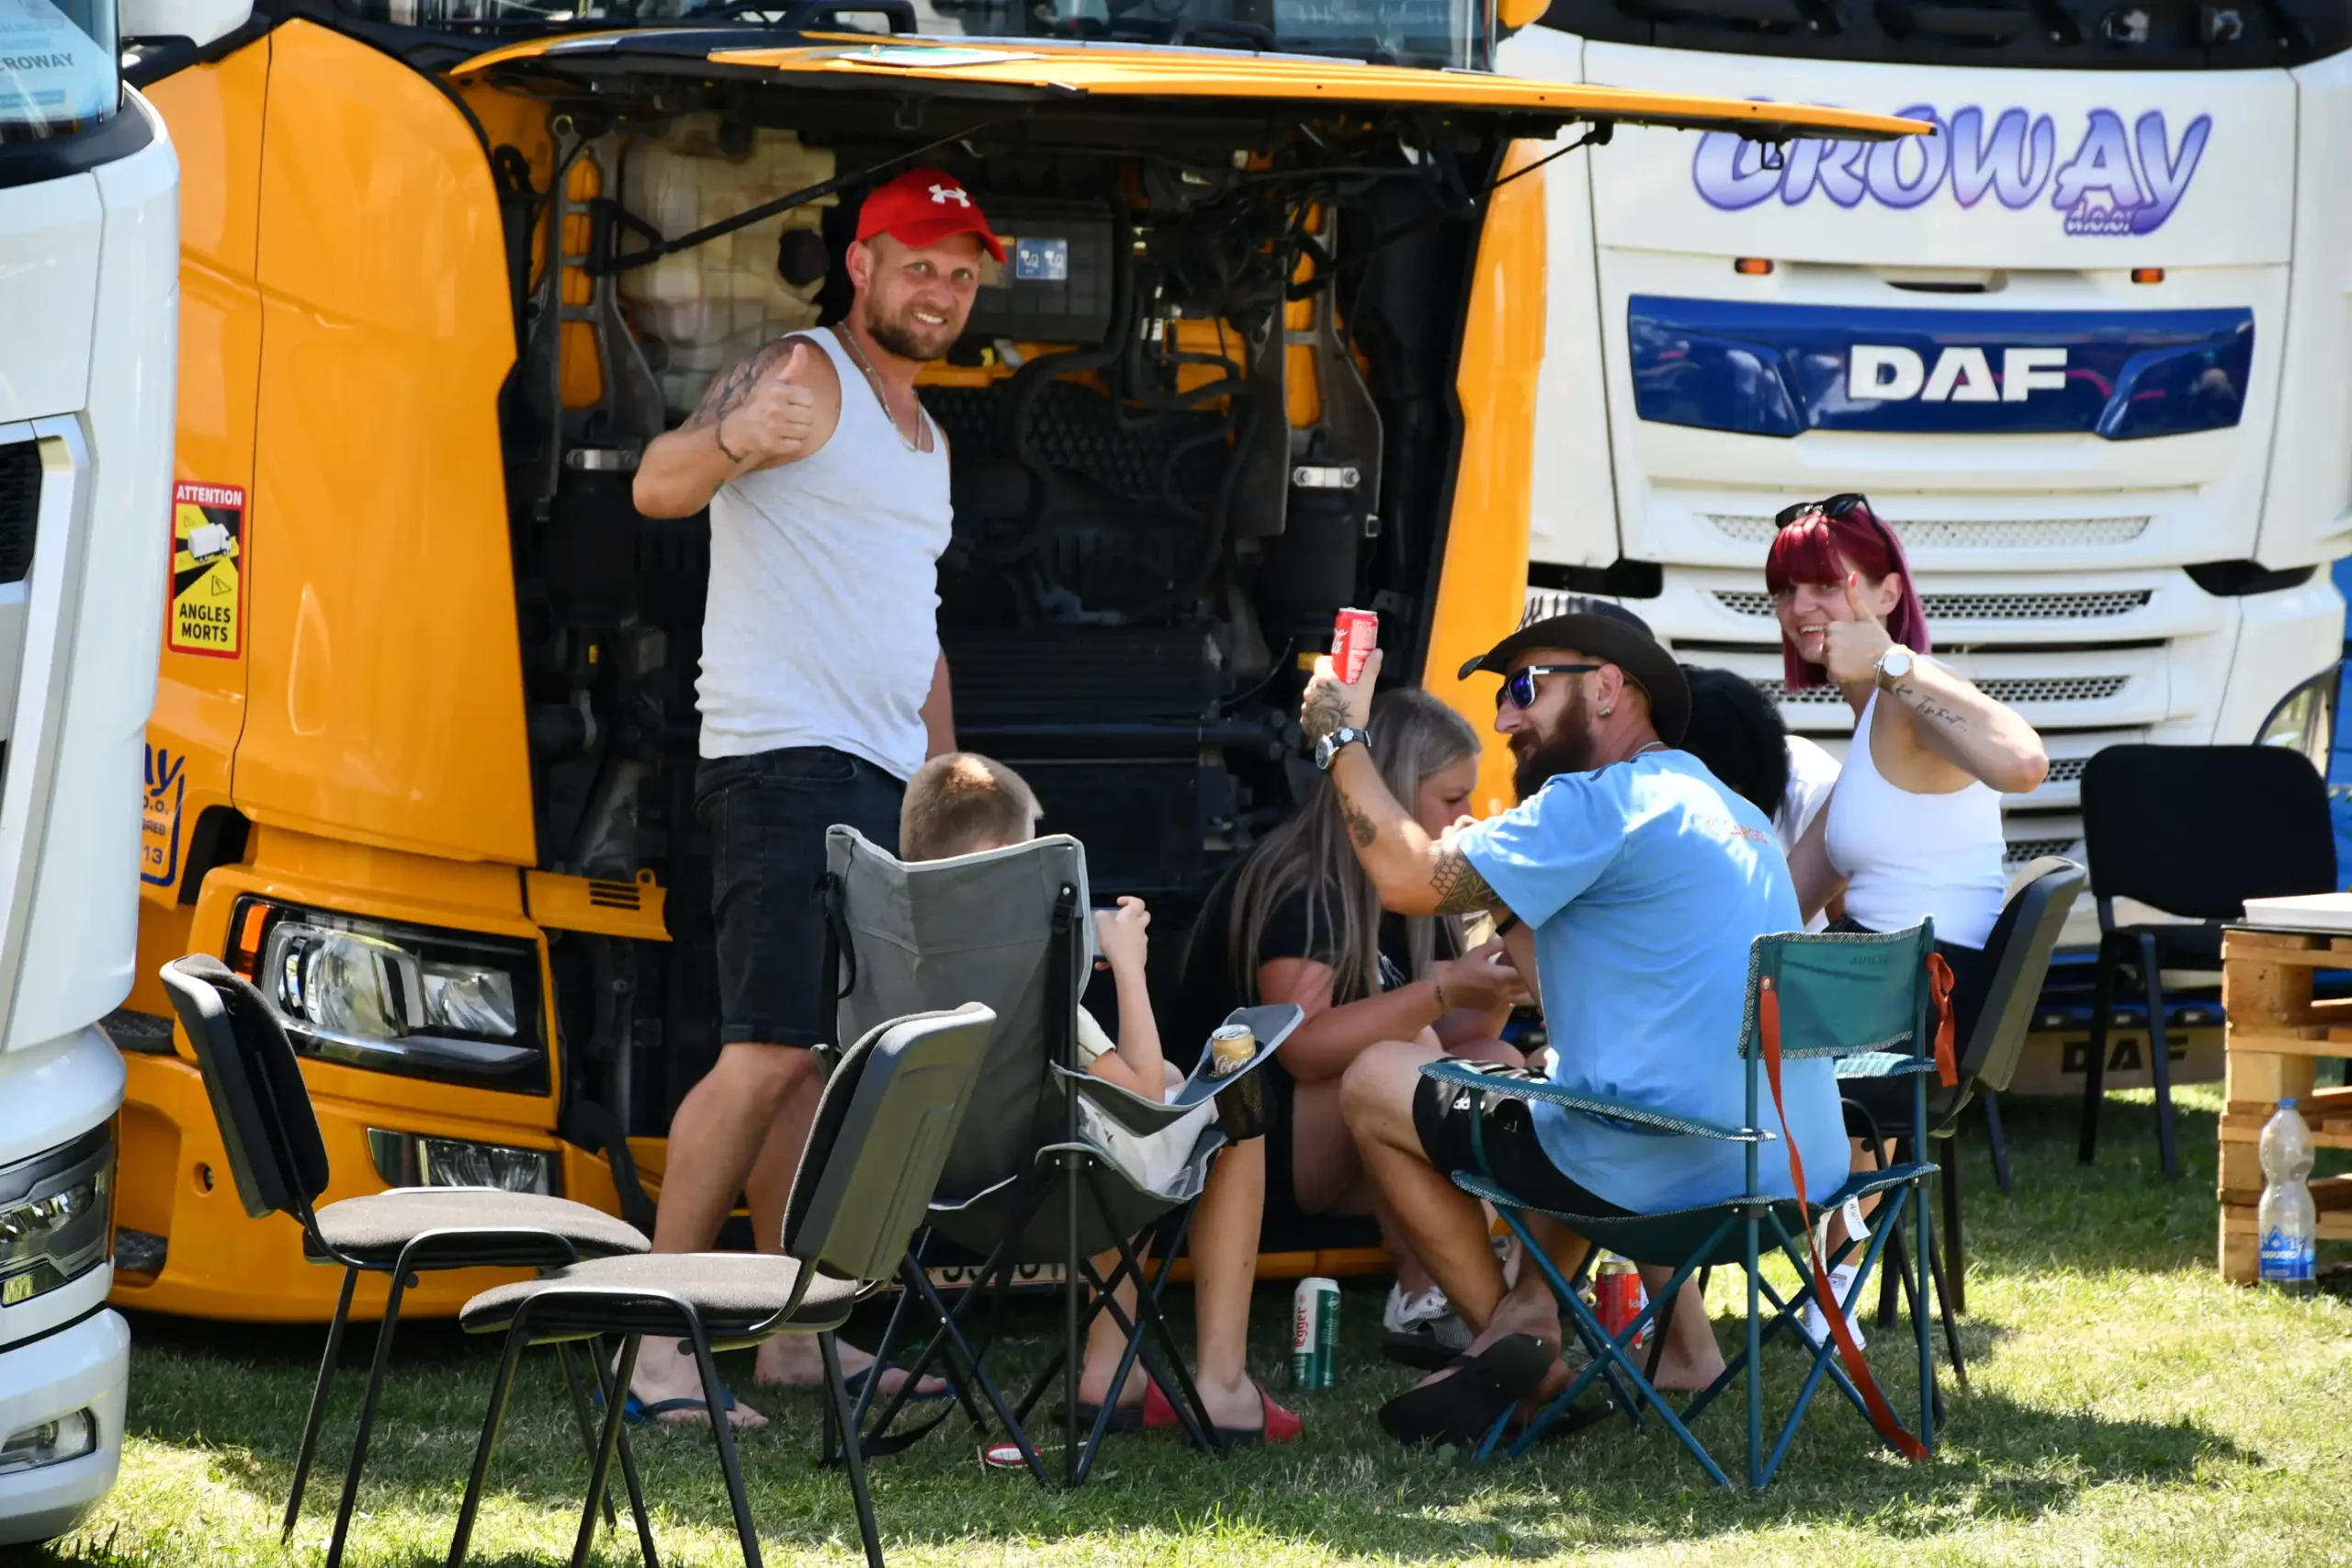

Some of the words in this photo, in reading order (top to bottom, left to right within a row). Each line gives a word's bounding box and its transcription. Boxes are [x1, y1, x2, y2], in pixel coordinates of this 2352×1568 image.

[0, 52, 74, 72] ROWAY
[1848, 344, 2068, 402] DAF
[176, 485, 243, 506] ATTENTION
[179, 603, 232, 624] ANGLES
[181, 622, 229, 643] MORTS
